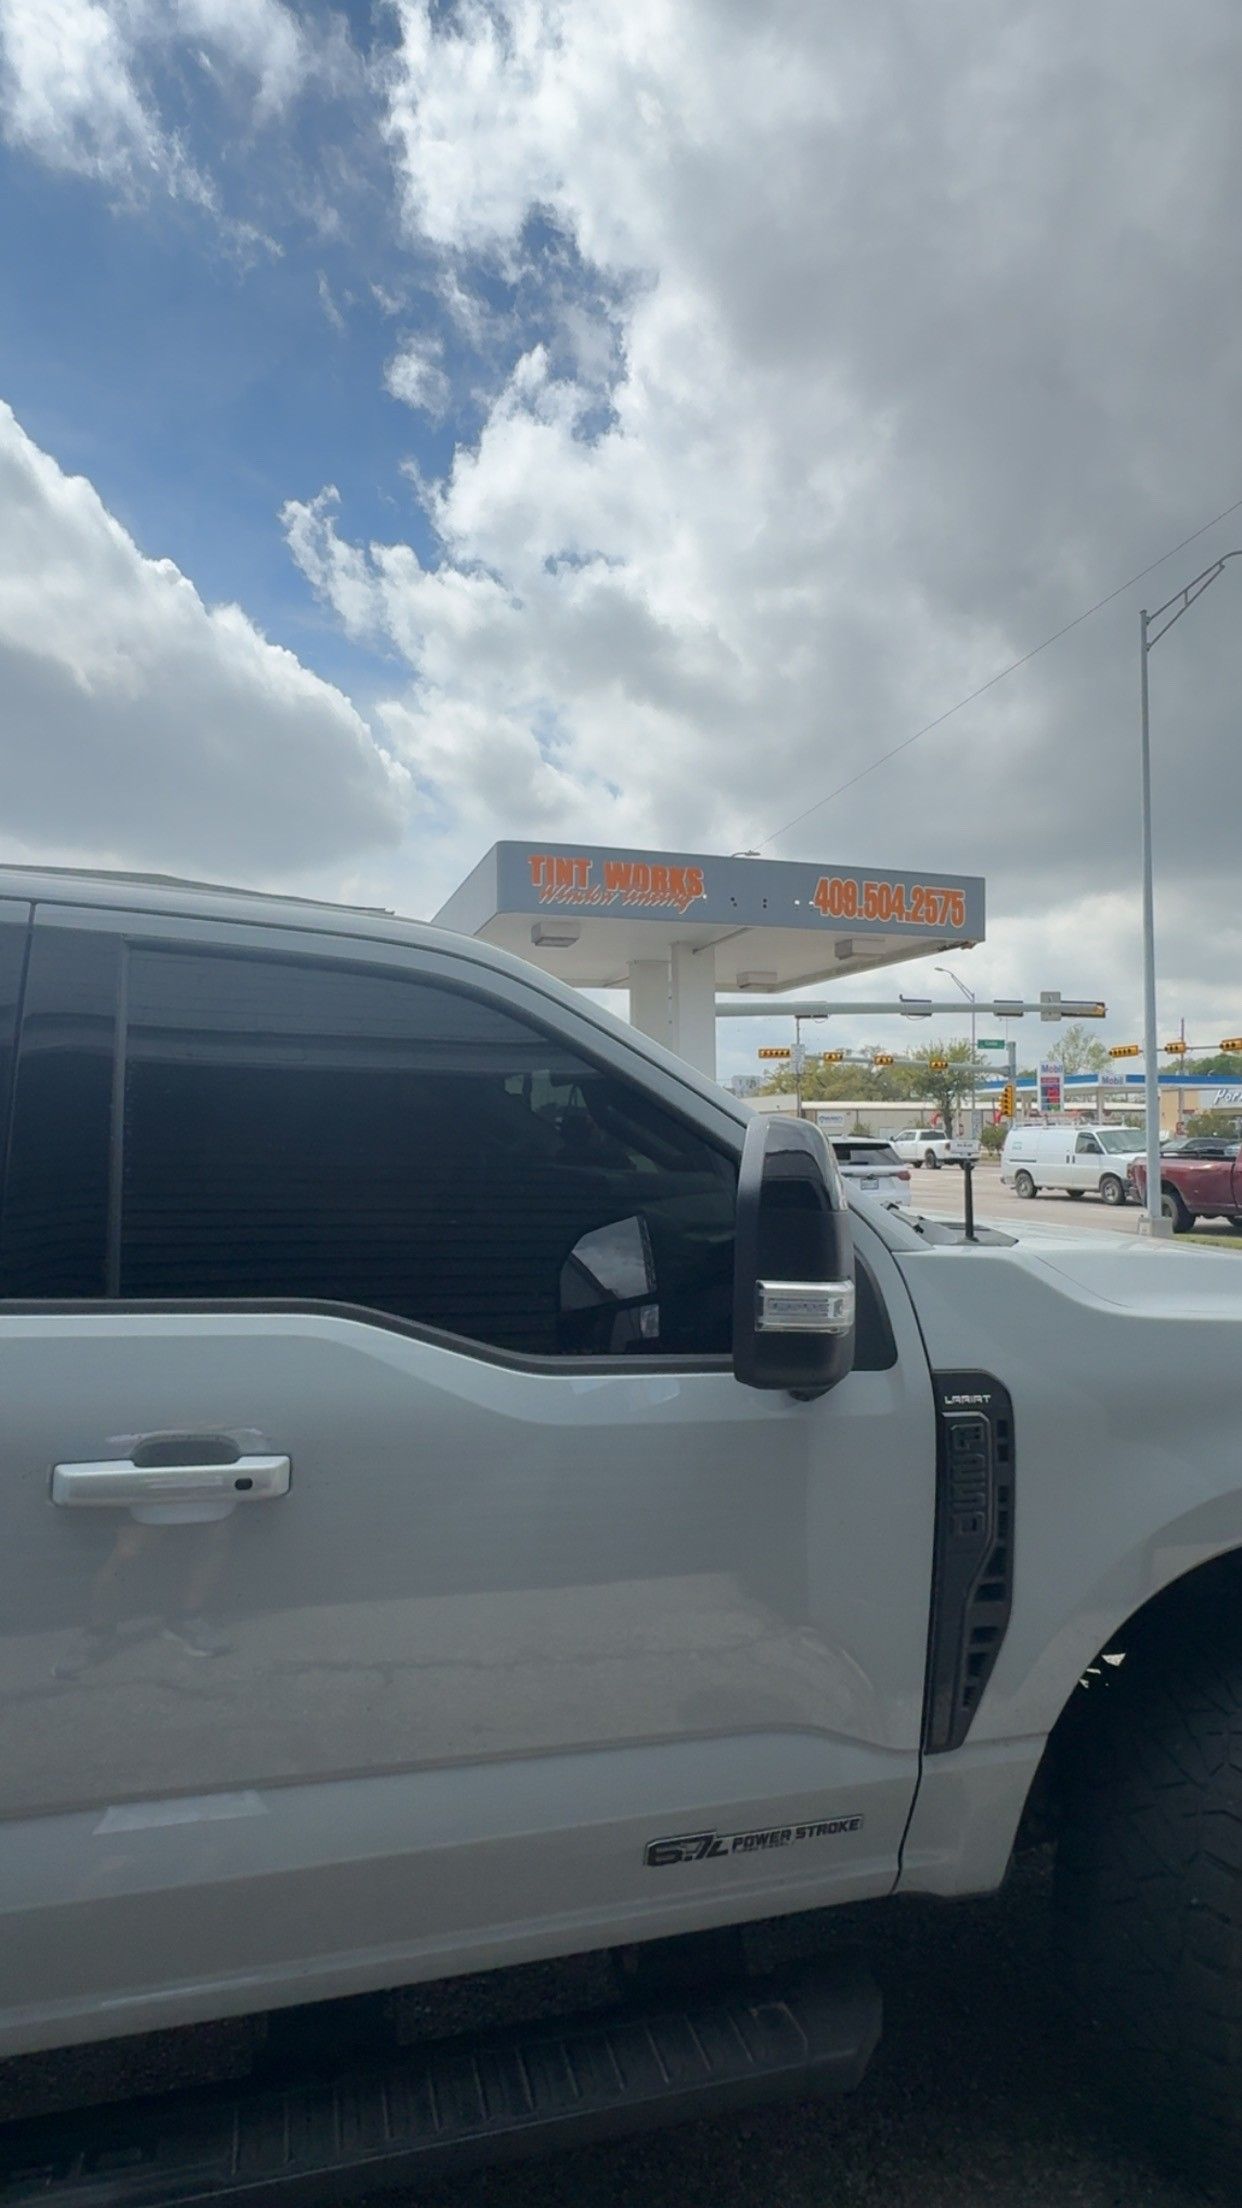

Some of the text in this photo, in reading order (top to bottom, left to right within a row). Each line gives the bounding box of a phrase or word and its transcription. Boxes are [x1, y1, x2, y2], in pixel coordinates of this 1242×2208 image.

[528, 855, 704, 898] TINT WORKS
[815, 876, 965, 928] 409.504.2575
[1041, 1064, 1063, 1073] Mobil
[1102, 1075, 1124, 1085] Mobil
[944, 1395, 991, 1404] LARIAT
[647, 1818, 861, 1867] 6.7L POWER STROKE
